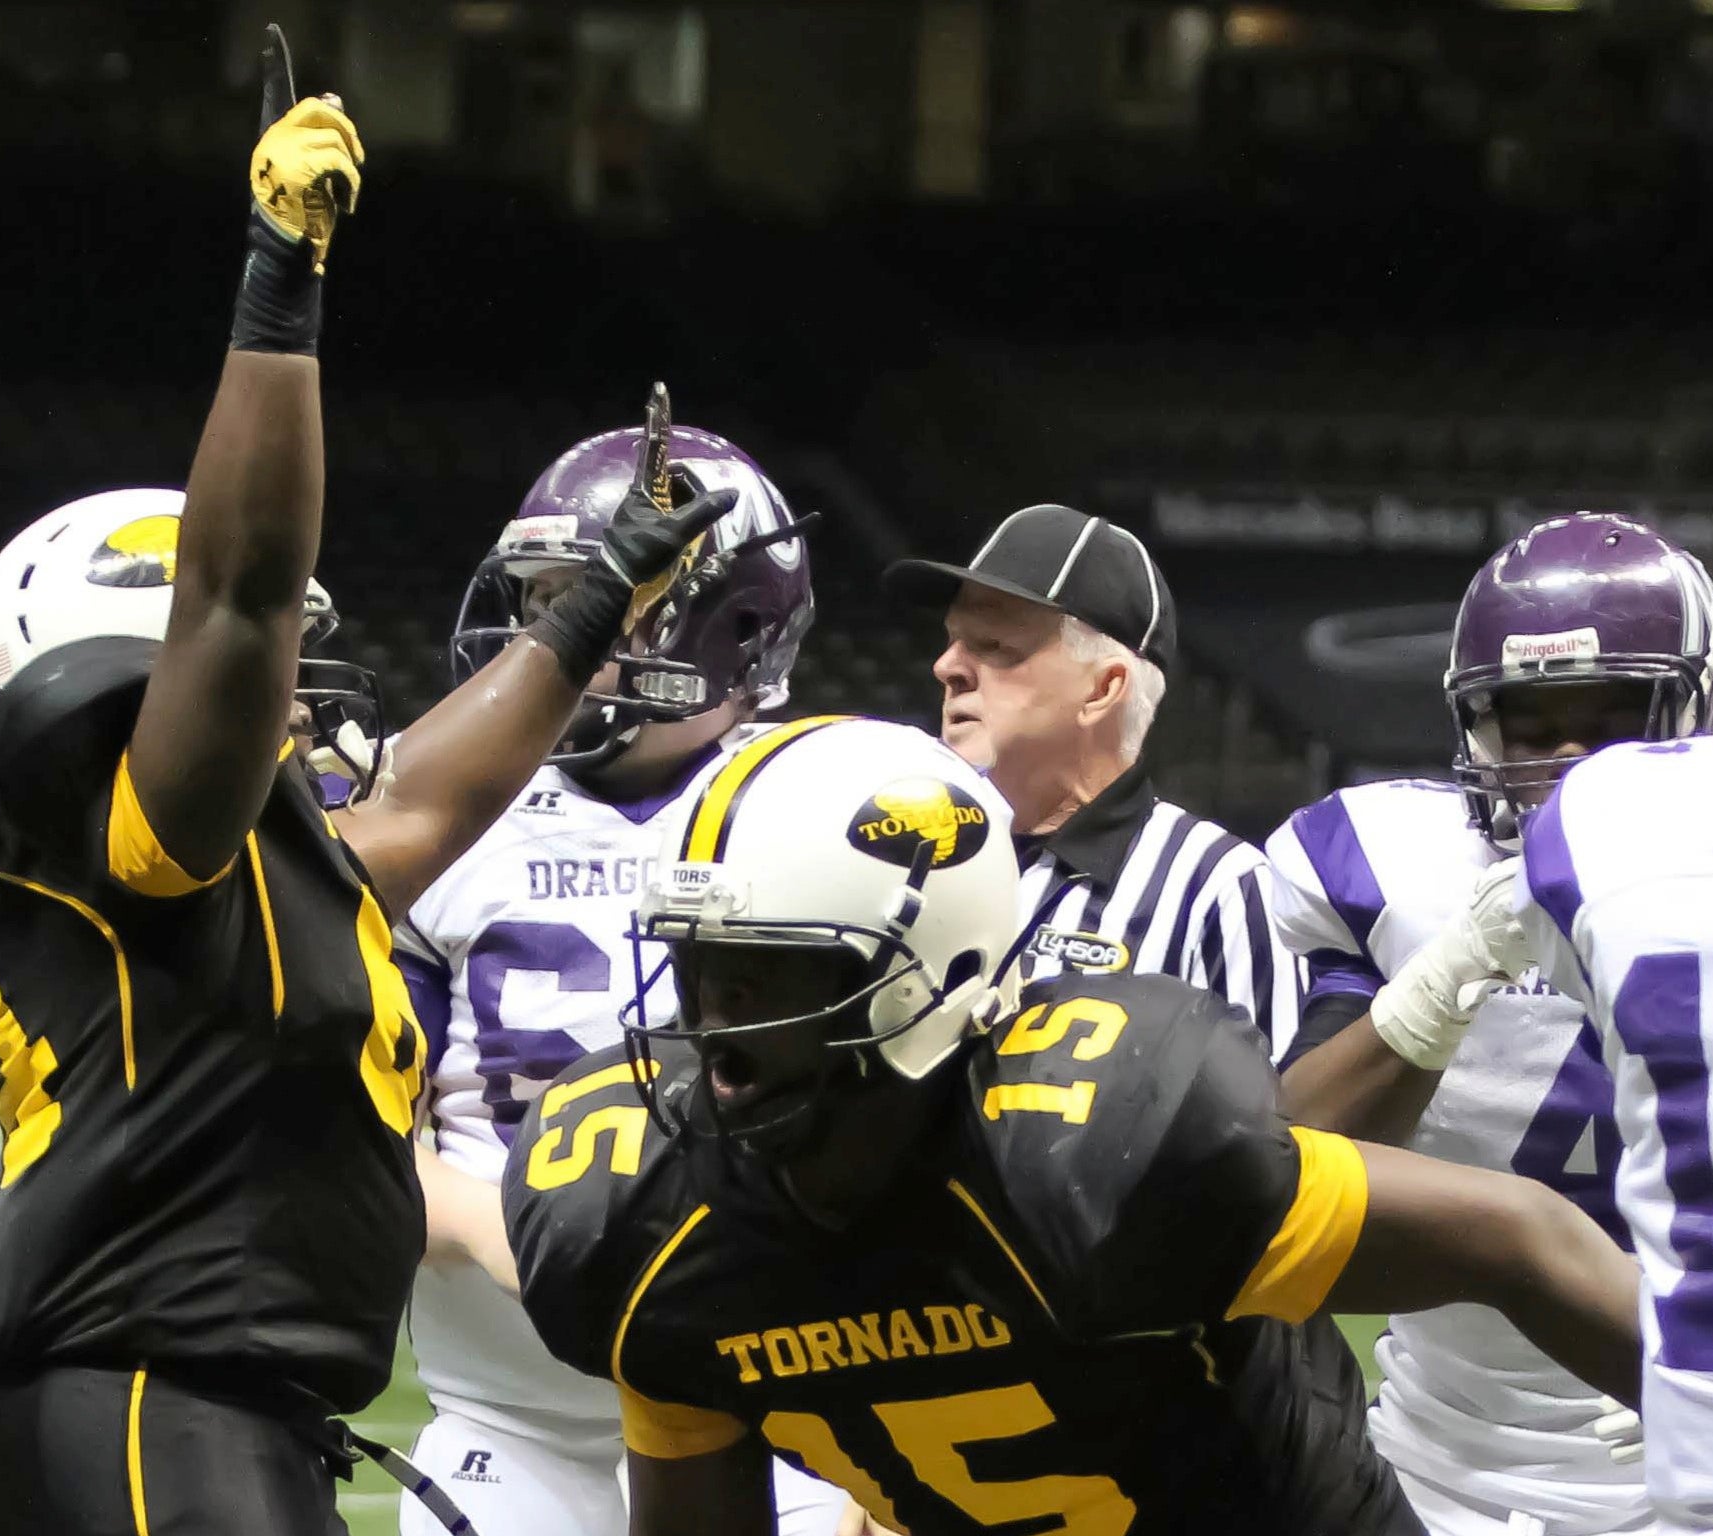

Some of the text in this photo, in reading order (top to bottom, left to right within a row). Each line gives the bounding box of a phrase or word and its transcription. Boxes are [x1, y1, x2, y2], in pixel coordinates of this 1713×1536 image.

[673, 869, 712, 884] TORS
[983, 996, 1130, 1126] 15
[524, 1056, 662, 1192] 15
[715, 1303, 1012, 1384] TORNADO
[451, 1471, 502, 1484] RUSSELL
